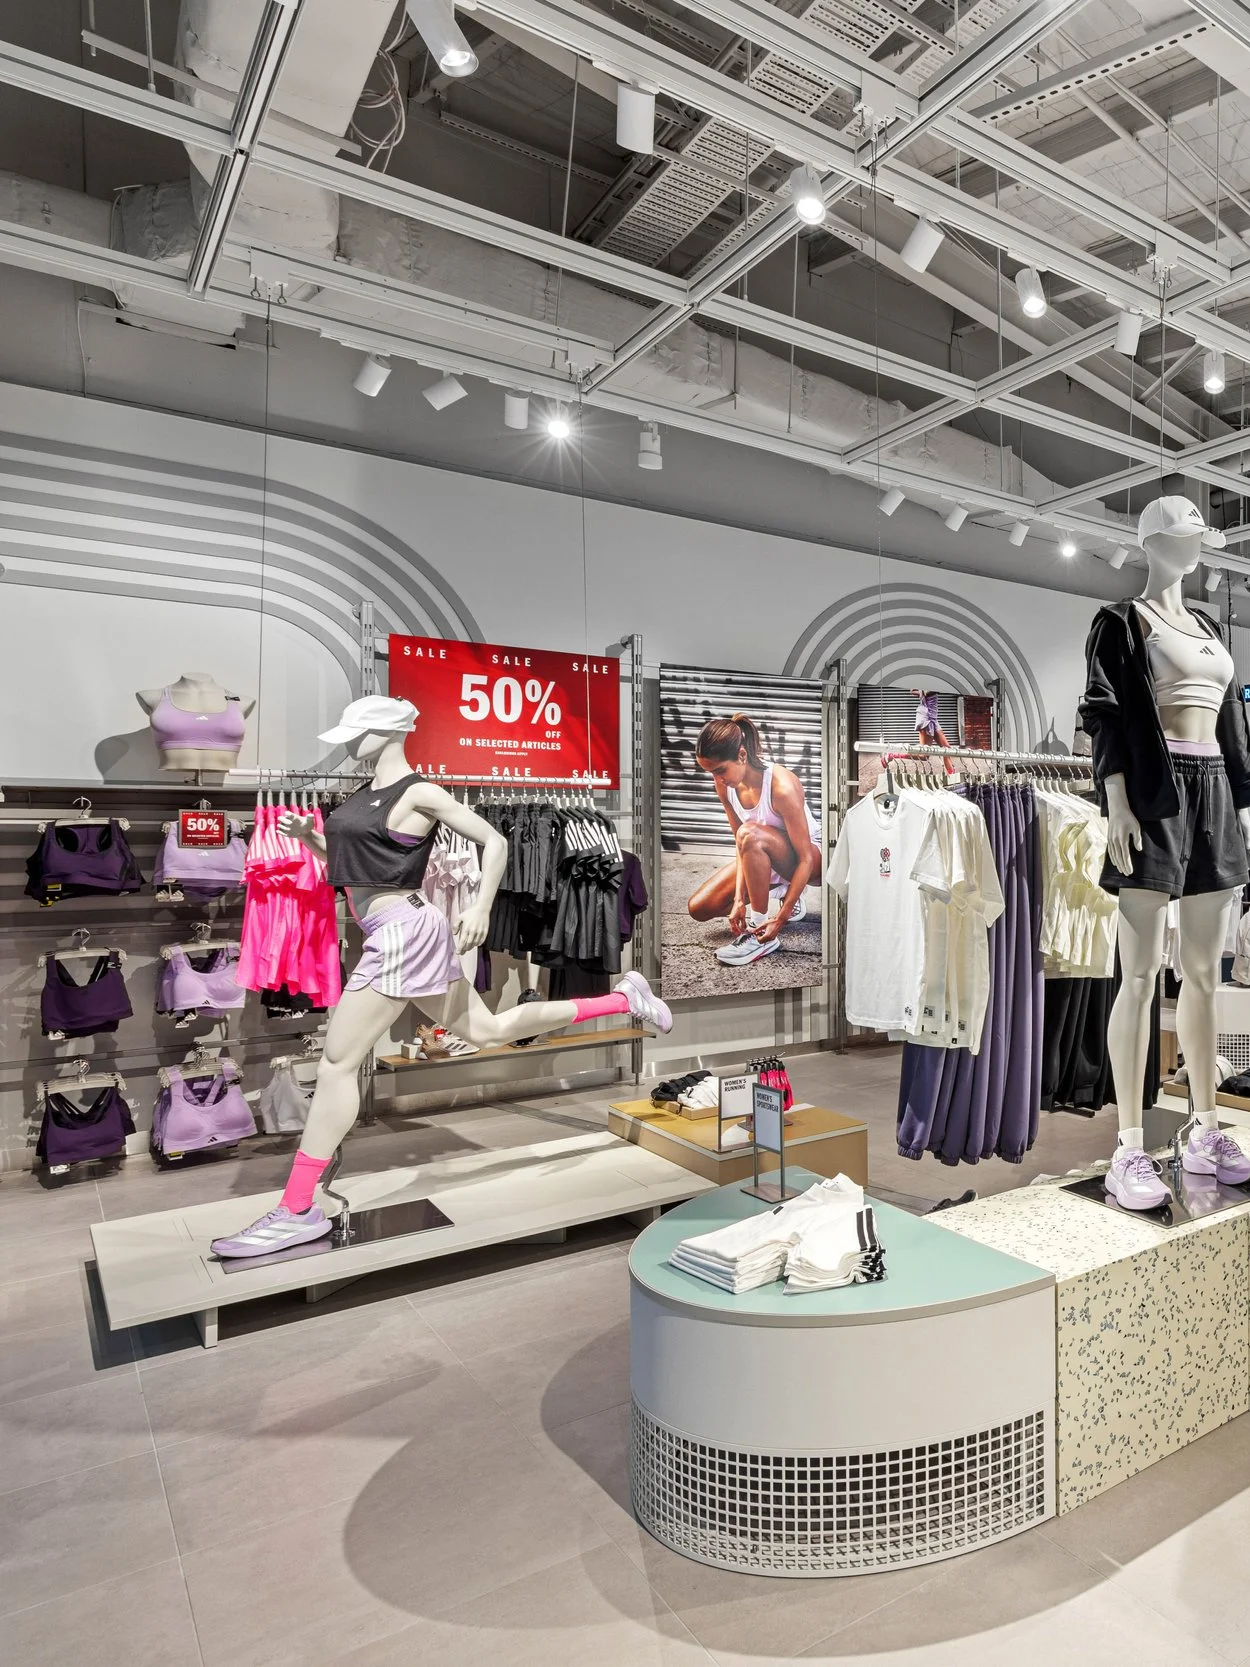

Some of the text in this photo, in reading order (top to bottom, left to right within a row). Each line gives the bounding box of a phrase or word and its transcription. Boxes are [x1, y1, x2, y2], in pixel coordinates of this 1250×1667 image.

[403, 645, 609, 674] SALE SALE SALE
[459, 673, 562, 726] 50%
[545, 730, 561, 739] OFF
[459, 738, 561, 751] ON SELECTED ARTICLES
[415, 763, 609, 779] ALE SALE SALE
[187, 818, 220, 831] 50%
[724, 1078, 747, 1086] WOMEN'S
[724, 1084, 746, 1092] RUNNING
[756, 1092, 773, 1103] WOMEN'S
